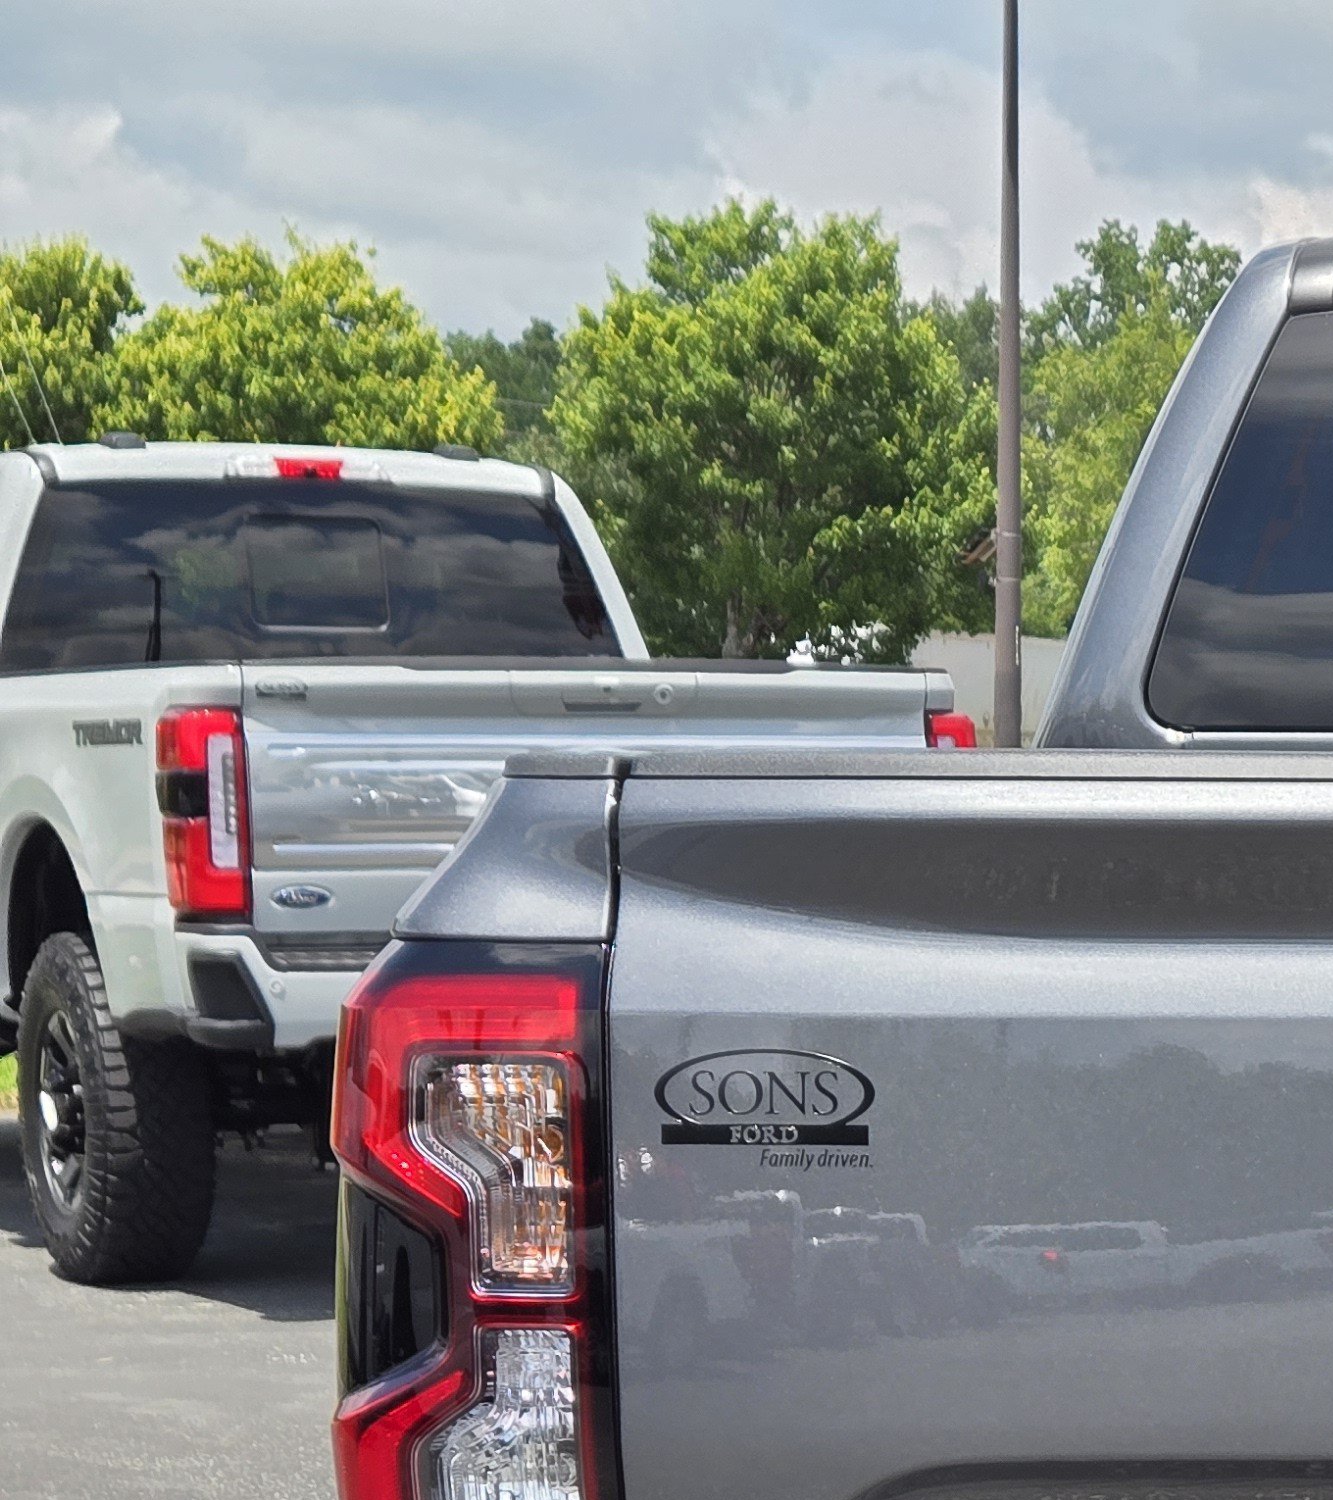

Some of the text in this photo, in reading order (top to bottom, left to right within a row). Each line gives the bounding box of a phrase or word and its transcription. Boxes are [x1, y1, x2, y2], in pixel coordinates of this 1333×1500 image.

[72, 718, 143, 746] TREMOR
[689, 1070, 839, 1116] SONS
[729, 1125, 799, 1144] FORD
[760, 1149, 874, 1172] Family driven.
